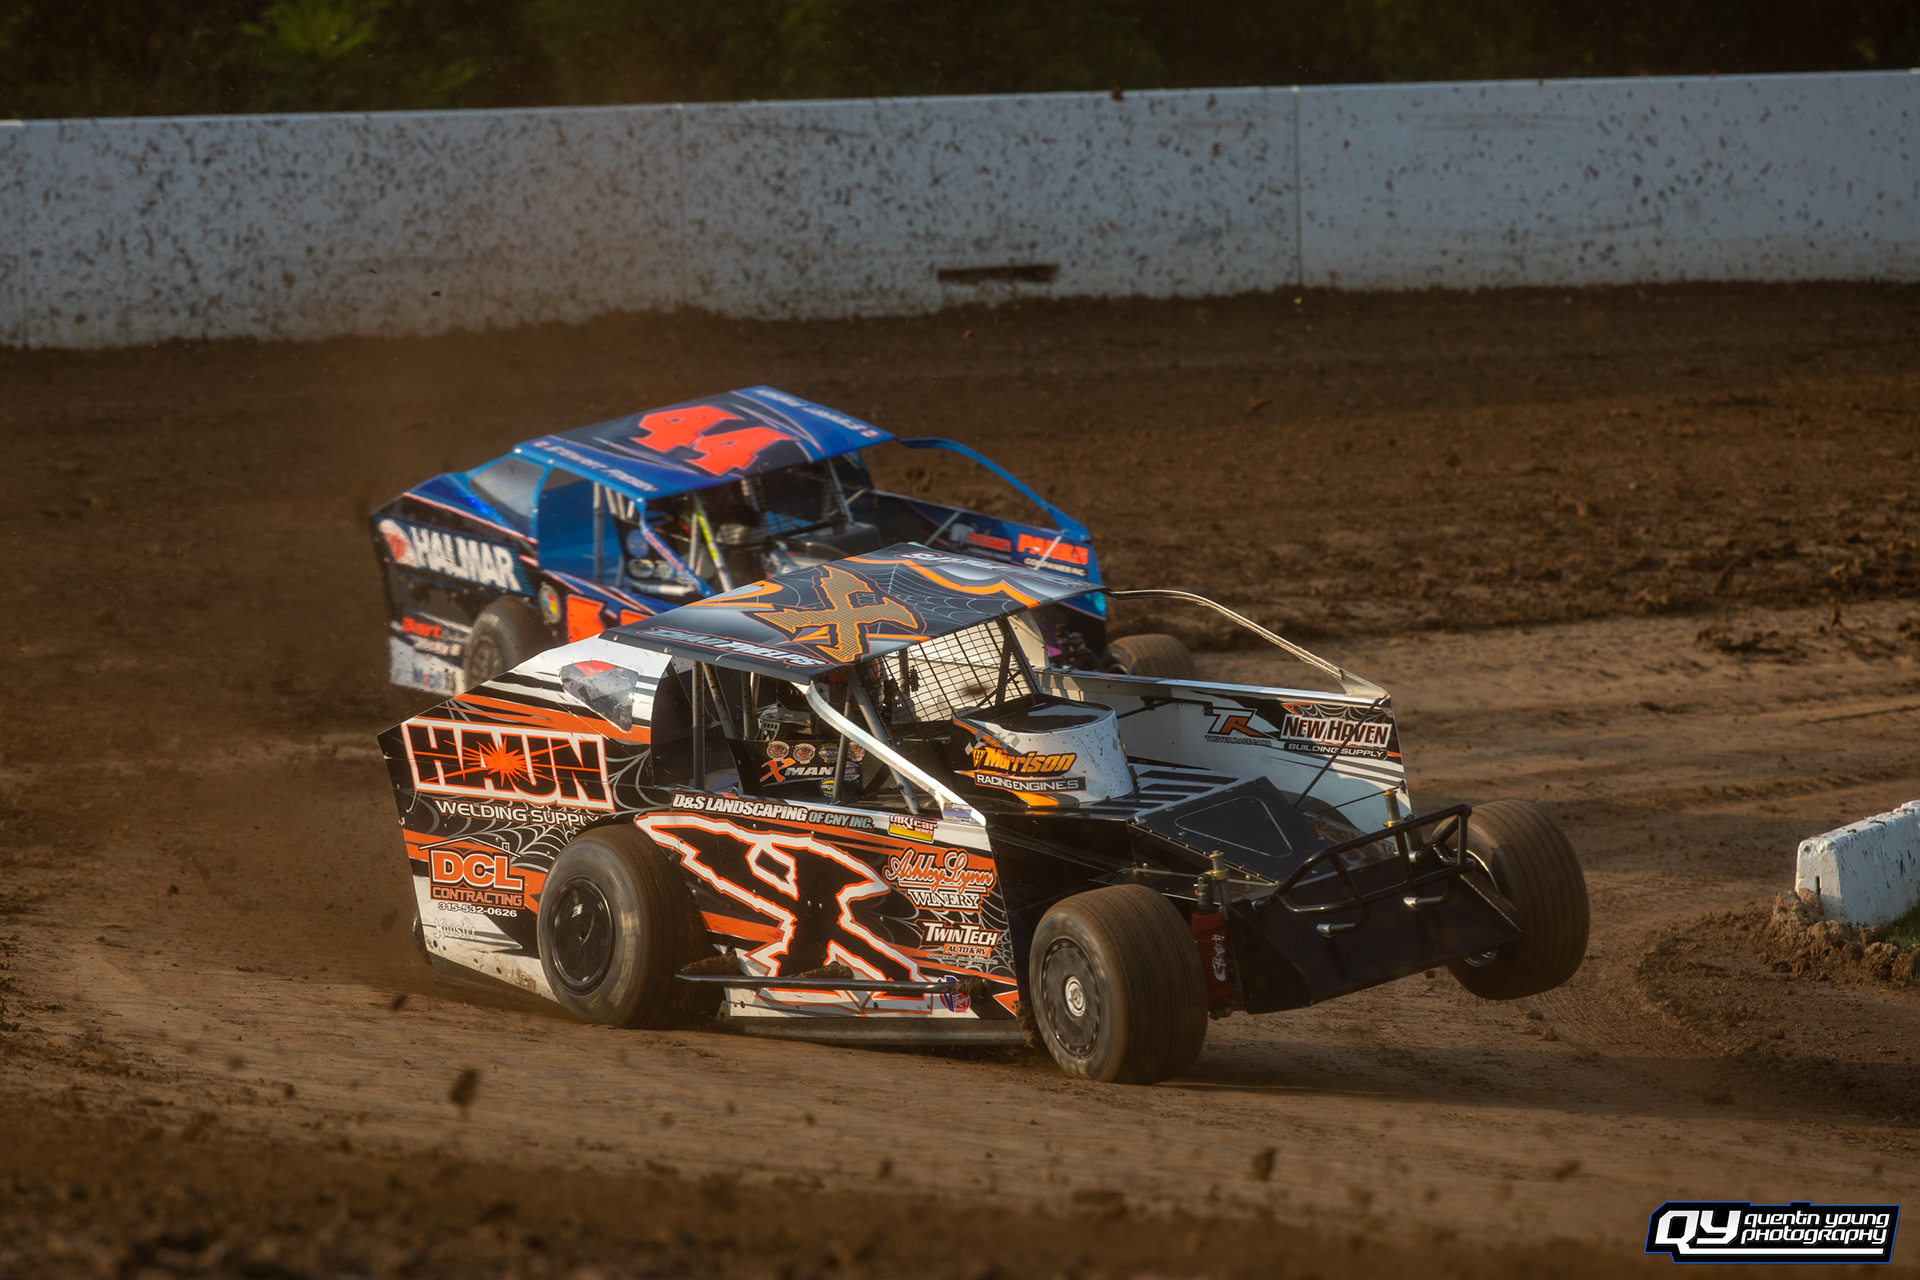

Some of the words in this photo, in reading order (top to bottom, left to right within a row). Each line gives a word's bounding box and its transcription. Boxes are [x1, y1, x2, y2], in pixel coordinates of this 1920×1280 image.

[630, 405, 800, 476] 44
[410, 526, 522, 591] HALMAR
[1017, 533, 1089, 566] PARKS
[1282, 715, 1327, 739] NEW
[1327, 719, 1390, 746] HAVEN
[406, 723, 608, 803] HAUN
[983, 747, 1077, 773] Morrison
[1288, 743, 1340, 754] BUILDING
[1340, 747, 1384, 758] SUPPLY
[976, 774, 1014, 789] RACING
[1013, 779, 1079, 792] ENGINES
[434, 800, 528, 822] WELDING
[530, 809, 600, 827] SUPPLY
[673, 793, 705, 810] D&S
[705, 795, 809, 822] LANDSCAPING
[808, 811, 824, 824] OF
[824, 812, 850, 828] CNY
[850, 815, 874, 830] INC.
[430, 850, 524, 891] DCL
[885, 849, 946, 893] Ashley
[943, 851, 995, 895] Lynn
[432, 886, 523, 907] CONTRACTING
[438, 902, 518, 918] 315-532-0626
[908, 889, 980, 909] WINERY
[434, 918, 477, 940] Hoosier
[947, 945, 969, 954] AUTO
[975, 947, 988, 955] RV
